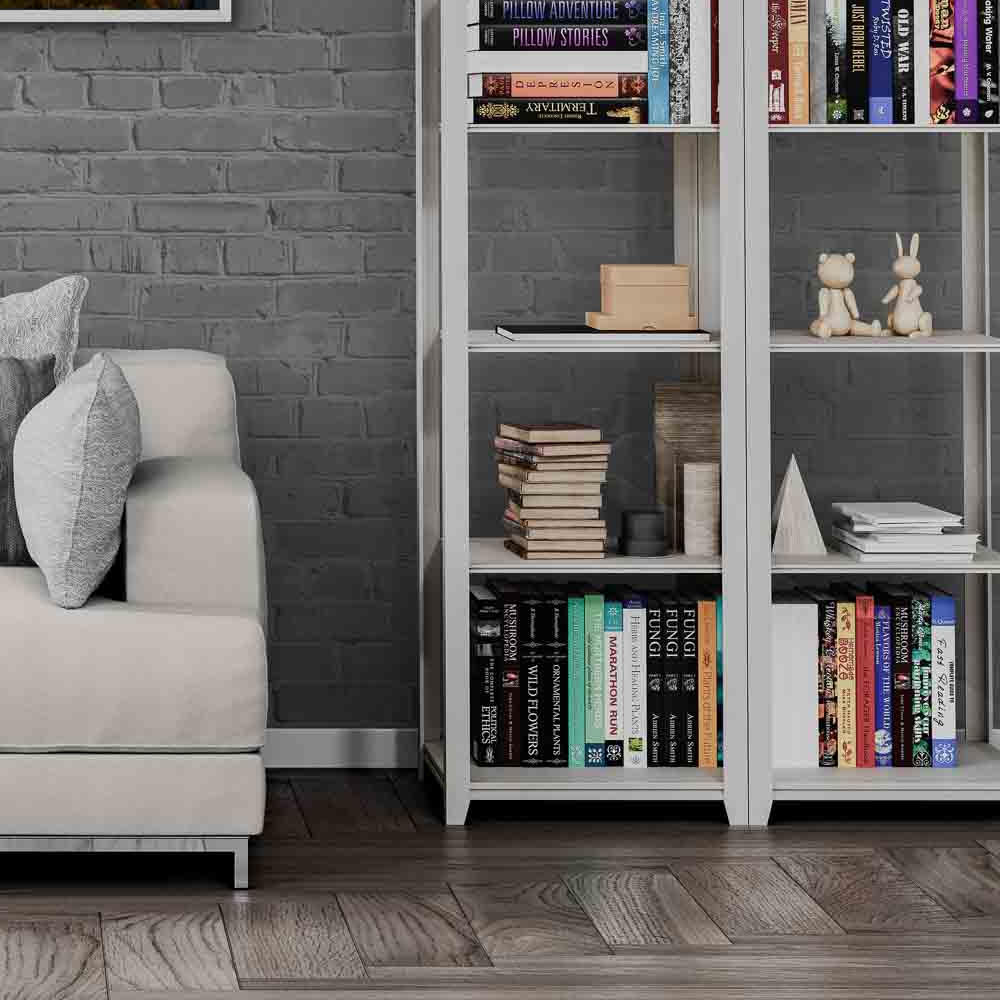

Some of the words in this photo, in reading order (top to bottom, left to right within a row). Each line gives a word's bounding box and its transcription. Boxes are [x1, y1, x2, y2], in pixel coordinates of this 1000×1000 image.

[503, 0, 546, 19] PILLOW
[550, 0, 618, 19] ADVENTURE
[851, 4, 865, 23] JUST
[898, 8, 910, 37] OLD
[513, 28, 556, 47] PILLOW
[560, 28, 609, 47] STORIES
[852, 25, 865, 47] BORN
[880, 0, 892, 59] TWISTED
[985, 27, 993, 54] Water
[852, 49, 865, 73] REBEL
[898, 41, 910, 73] WAR
[526, 102, 598, 116] TERMITARY
[508, 603, 518, 662] MUSHROOM
[648, 609, 661, 658] FUNGI
[666, 609, 679, 658] FUNGI
[683, 609, 696, 658] FUNGI
[882, 620, 890, 660] FLAVORS
[900, 607, 909, 663] MUSHROOM
[882, 661, 890, 673] OF
[937, 637, 948, 667] Fast
[527, 664, 539, 697] WILD
[609, 636, 618, 706] MARATHON
[882, 675, 890, 694] THE
[552, 664, 561, 722] ORNAMENTAL
[933, 674, 948, 727] Reading
[481, 705, 491, 744] ETHICS
[527, 699, 539, 756] FLOWERS
[609, 710, 618, 736] RUN
[882, 696, 890, 729] WORLD
[552, 723, 561, 756] PLANTS
